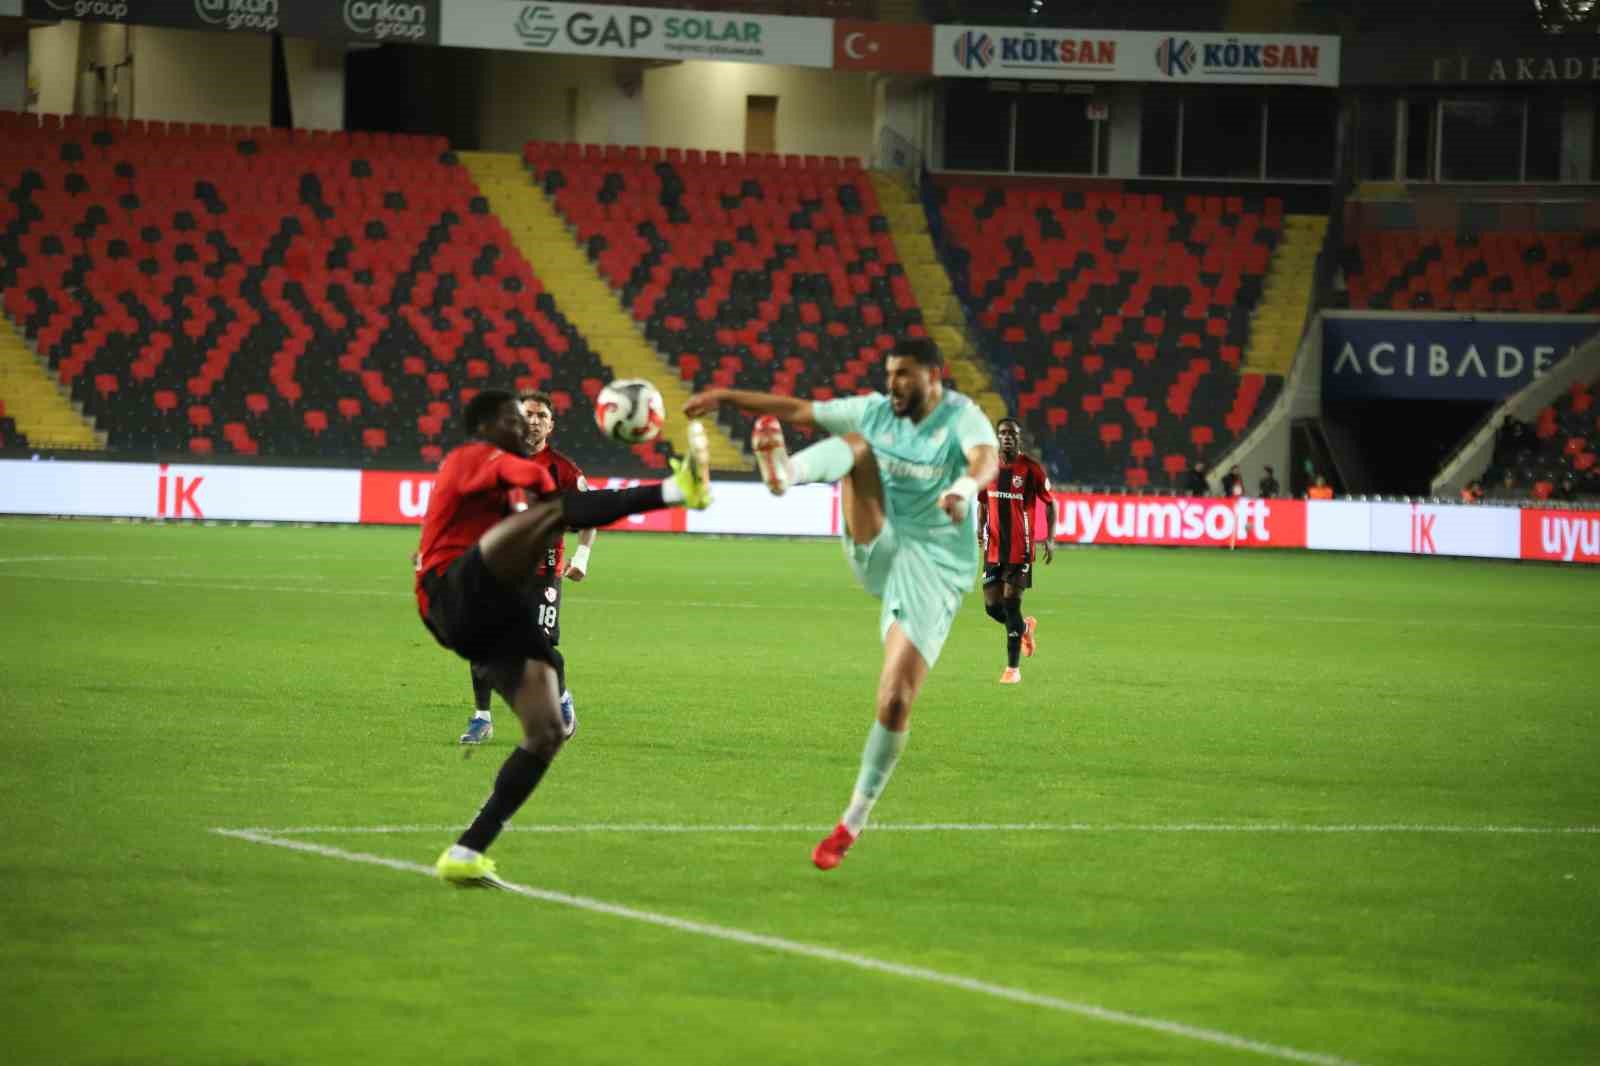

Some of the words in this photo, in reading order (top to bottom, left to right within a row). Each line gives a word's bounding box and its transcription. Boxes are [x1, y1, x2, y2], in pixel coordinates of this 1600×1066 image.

[566, 12, 652, 48] GAP
[663, 16, 762, 43] SOLAR
[1001, 32, 1117, 65] KÖKSAN
[1203, 39, 1320, 70] KÖKSAN
[1333, 341, 1577, 378] ACIBADE
[538, 604, 557, 628] 18
